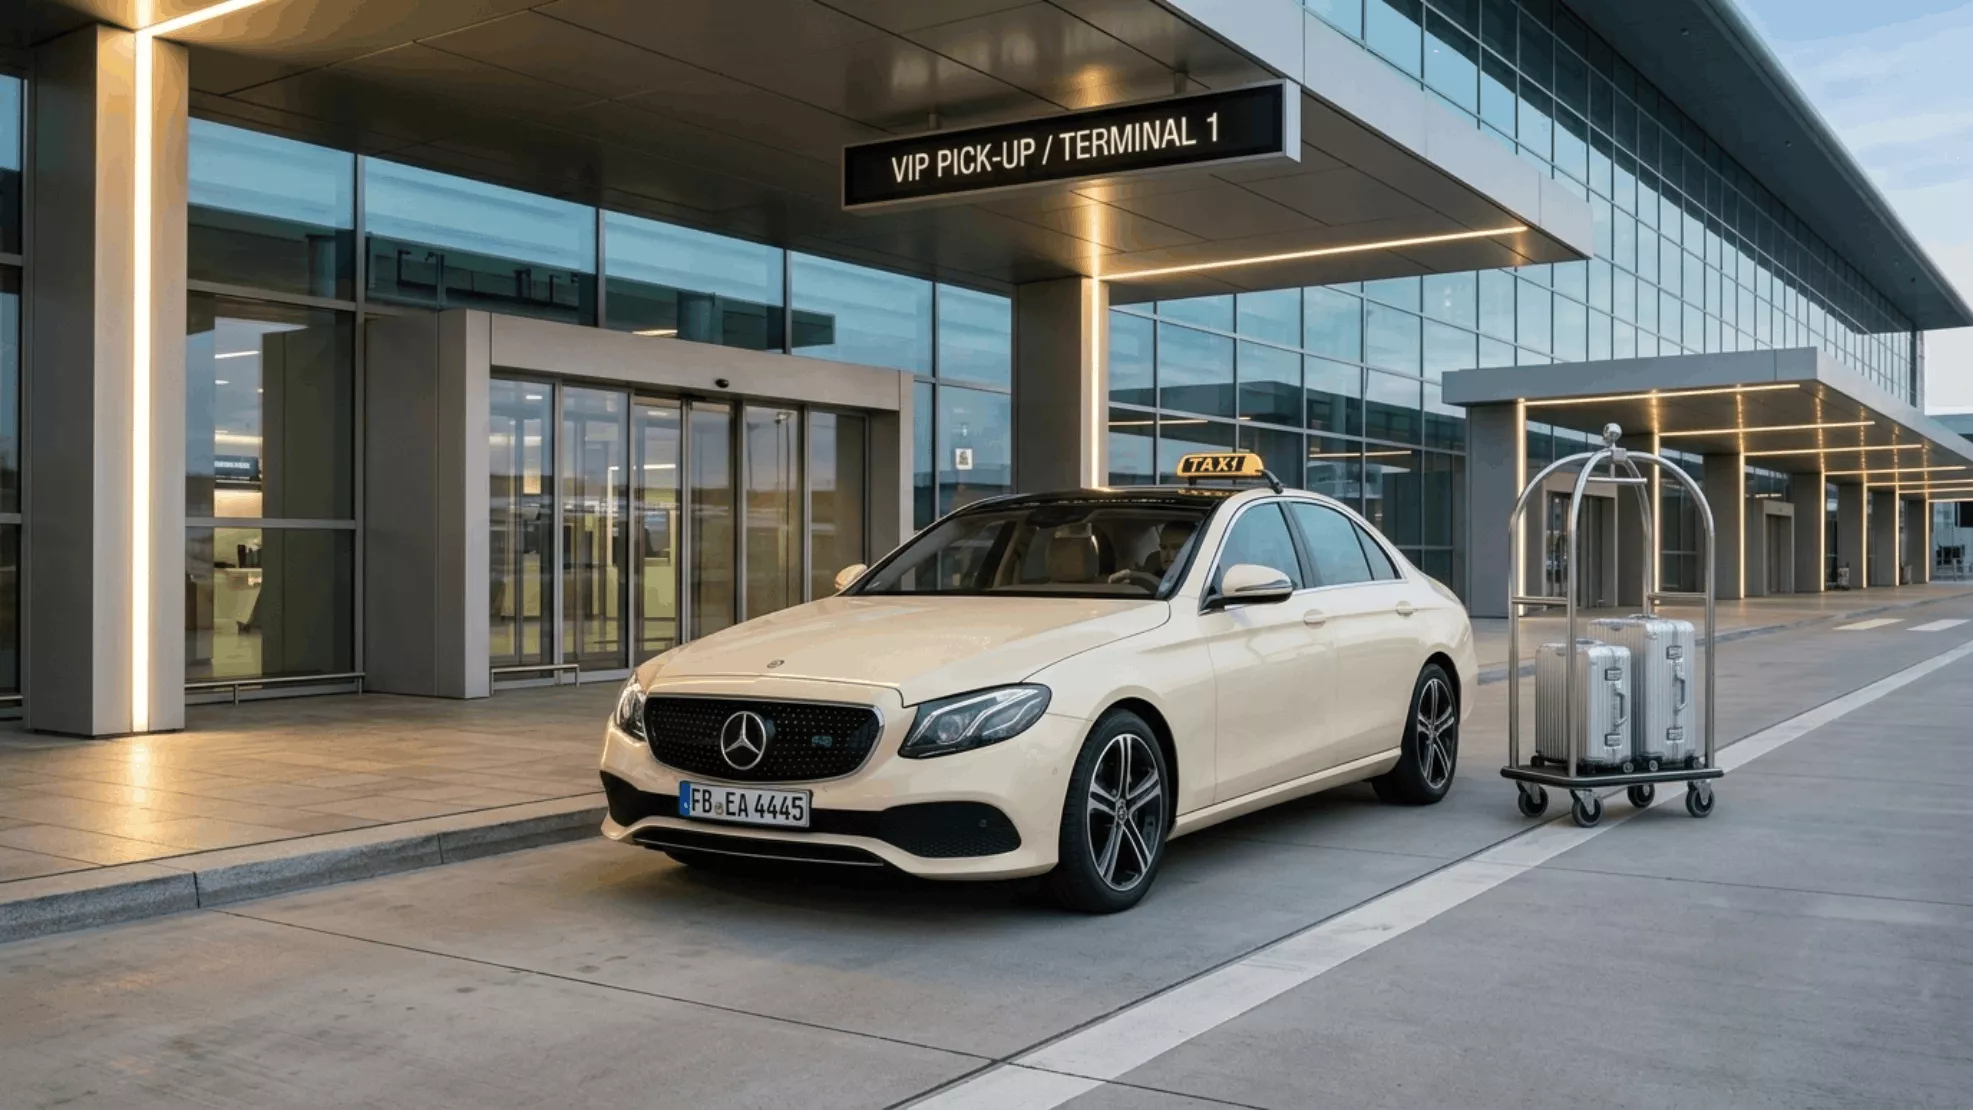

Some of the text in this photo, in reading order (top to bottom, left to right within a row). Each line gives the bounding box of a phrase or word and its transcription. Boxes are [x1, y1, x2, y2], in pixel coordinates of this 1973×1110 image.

[891, 112, 1219, 183] VIP PICK-UP / TERMINAL 1
[691, 788, 804, 821] FB EA 4445
